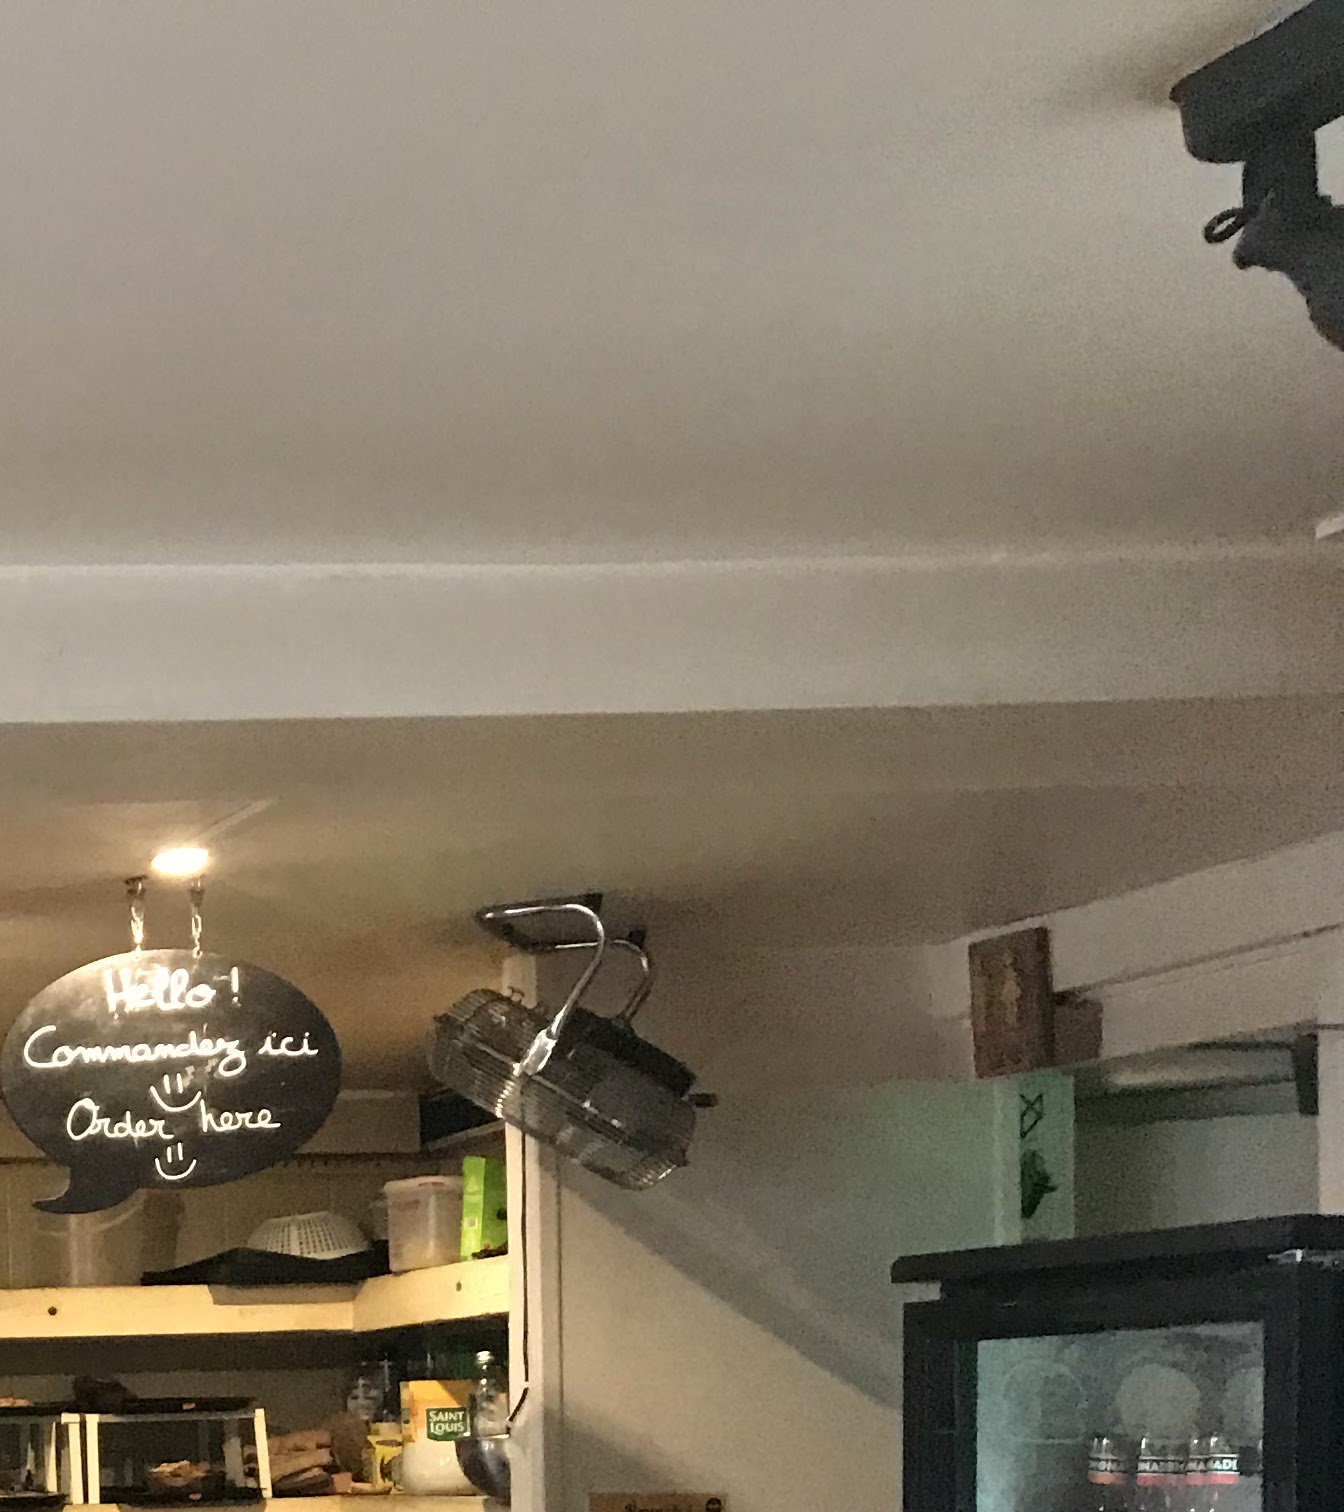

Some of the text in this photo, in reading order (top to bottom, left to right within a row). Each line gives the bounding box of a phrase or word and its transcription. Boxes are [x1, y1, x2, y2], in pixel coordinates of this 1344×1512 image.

[103, 967, 216, 1017] Hello
[23, 1025, 319, 1077] Commandez ici
[66, 1097, 282, 1141] Order here
[429, 1411, 464, 1422] SAINT
[430, 1422, 464, 1435] LOUIS
